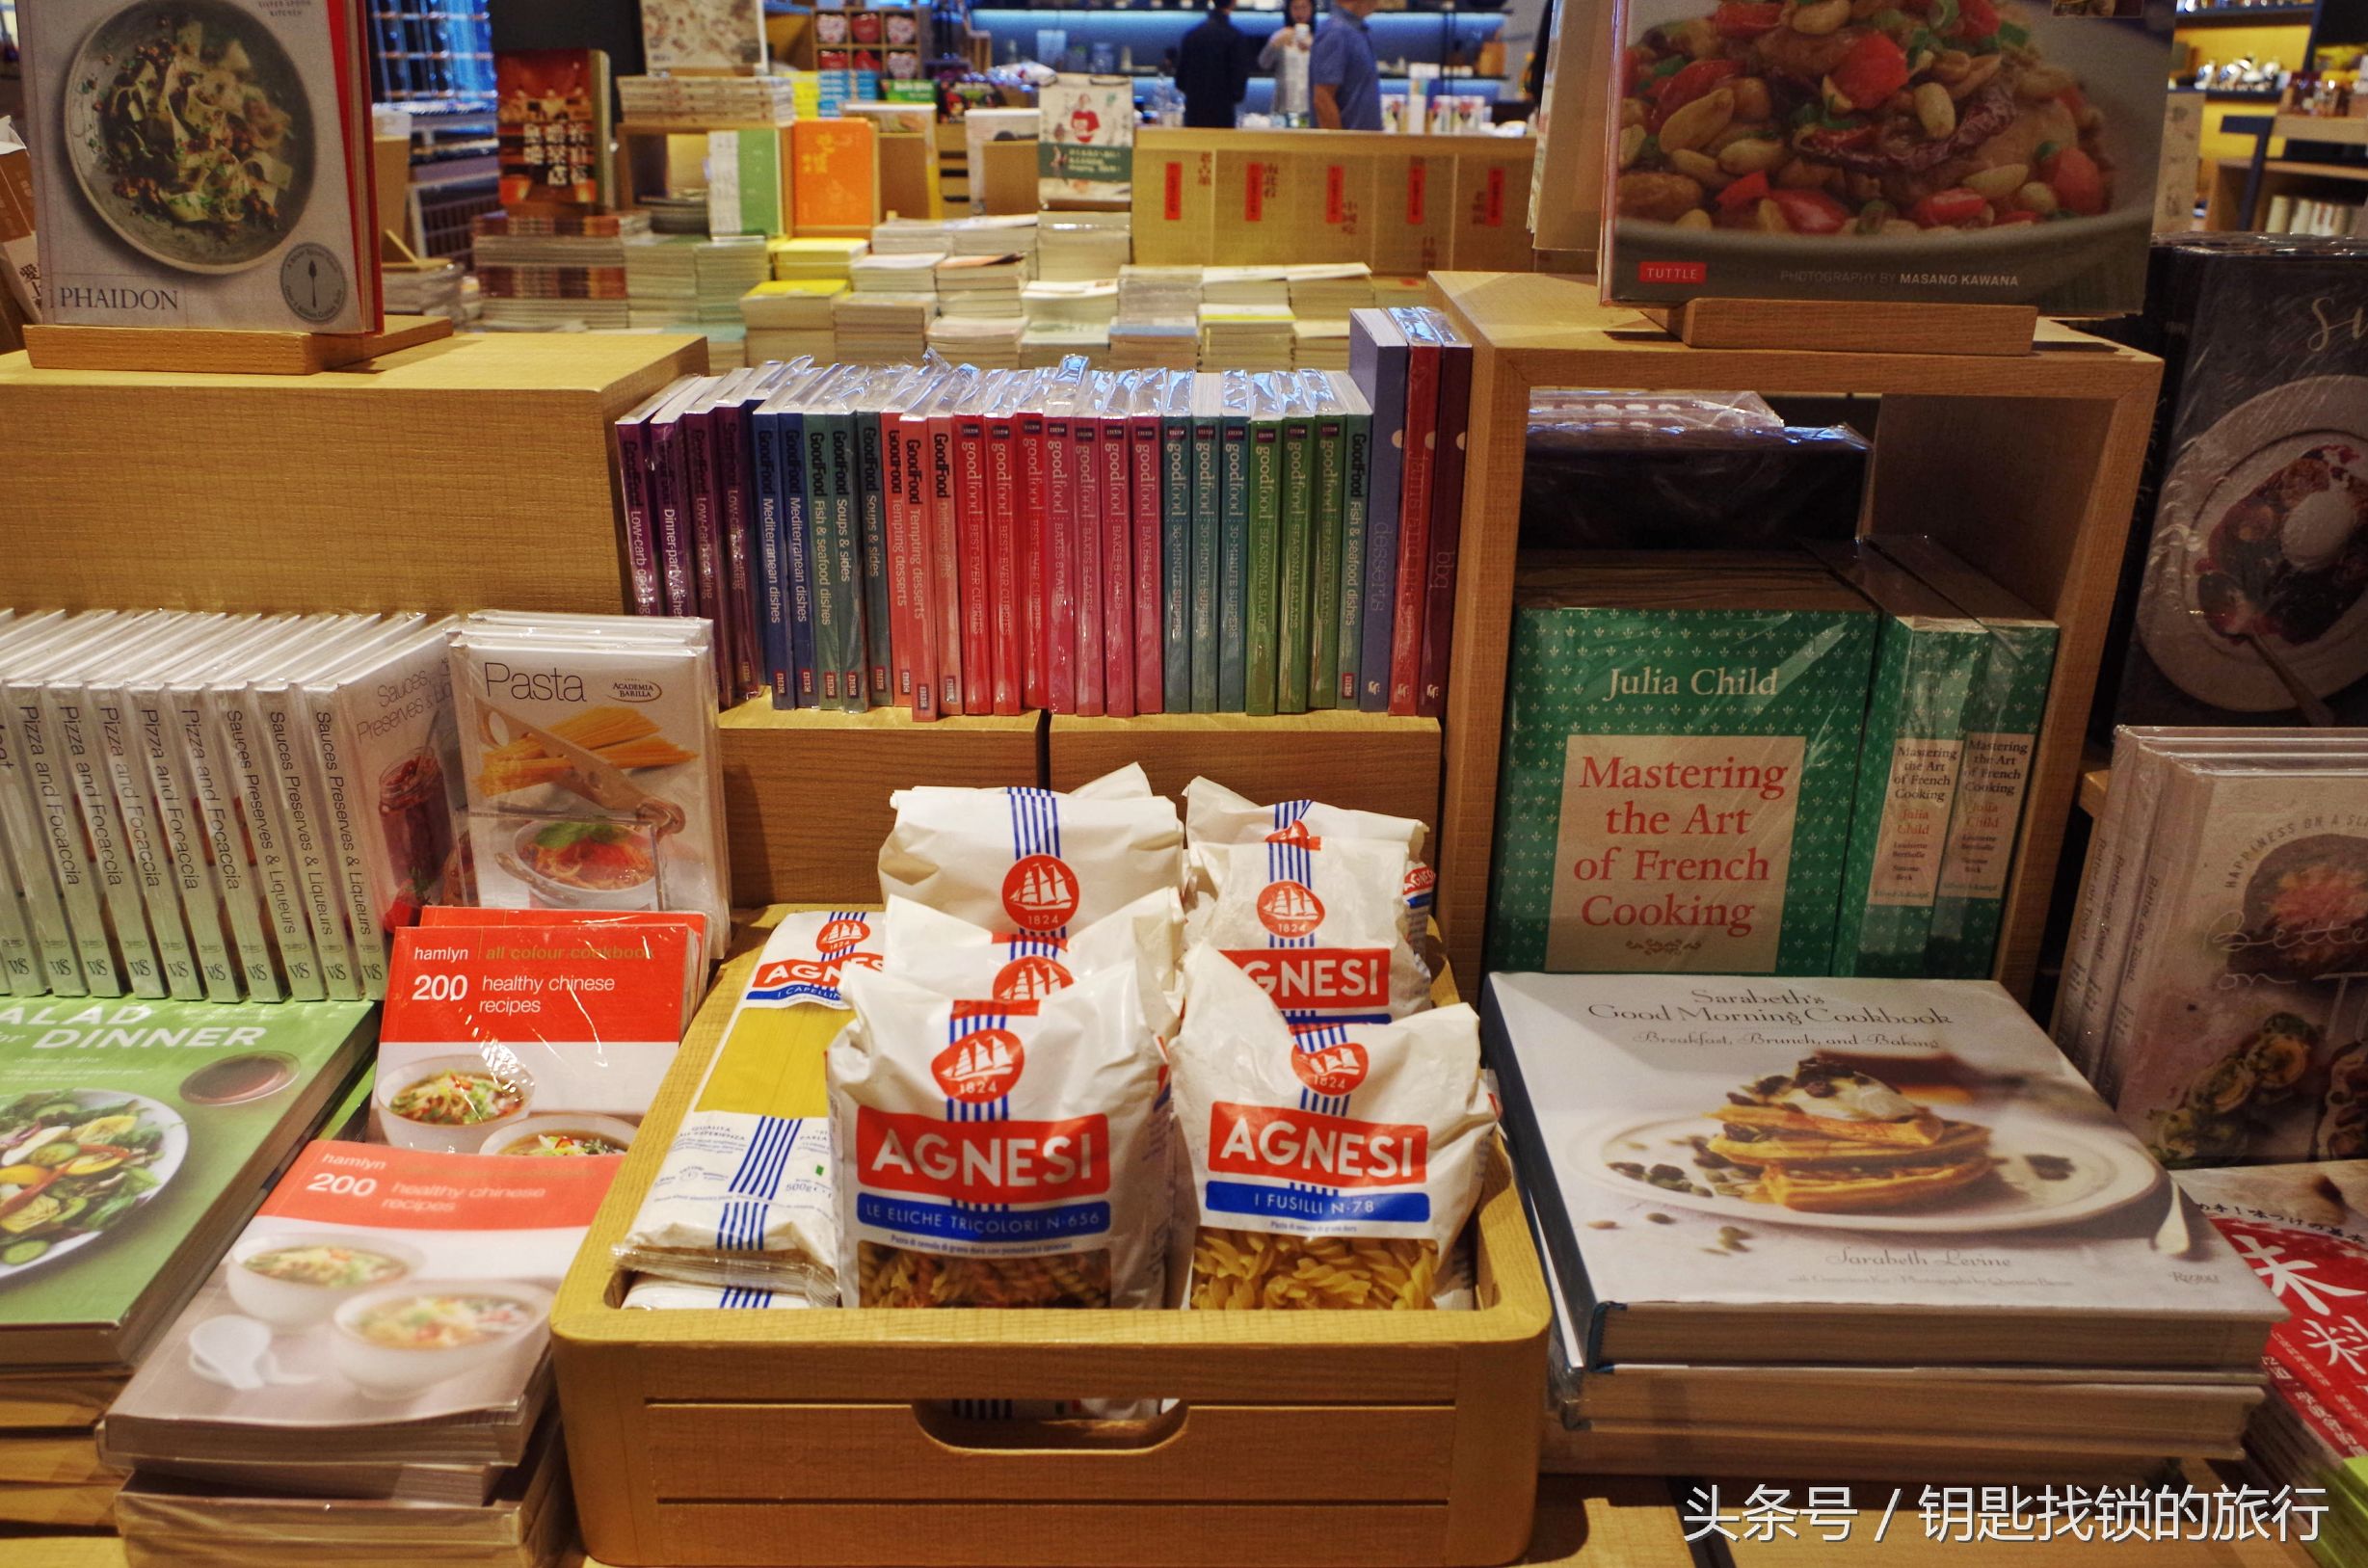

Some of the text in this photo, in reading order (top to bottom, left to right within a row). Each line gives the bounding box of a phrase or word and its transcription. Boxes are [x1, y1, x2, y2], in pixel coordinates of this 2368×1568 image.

[1646, 268, 1698, 280] TUTTLE
[1780, 270, 2020, 287] PHOTOGRAPHY BY MASANO KAWANA
[61, 287, 178, 310] PHAIDON
[934, 433, 950, 499] GoodFood
[1350, 433, 1367, 498] GoodFood
[837, 499, 848, 536] Soups
[866, 494, 877, 531] Soups
[1350, 501, 1362, 526] Fish
[810, 432, 832, 625] GoodFood Fish & seafood dishes
[838, 539, 850, 547] &
[906, 439, 924, 619] GoodFood Tempting desserts
[762, 498, 781, 624] Mediterranean dishes
[789, 497, 808, 623] Mediterranean dishes
[839, 551, 850, 582] sides
[868, 545, 880, 577] sides
[1348, 539, 1360, 586] seafood
[1371, 520, 1394, 612] desserts
[1430, 551, 1455, 590] bbq
[894, 555, 907, 607] desserts
[1345, 589, 1358, 626] dishes
[484, 662, 587, 703] Pasta
[613, 682, 653, 692] ACADEMIA
[619, 690, 652, 699] BARILLA
[1602, 666, 1778, 702] Julia Child
[356, 700, 424, 744] Preserves
[1897, 747, 1958, 760] Mastering
[1968, 739, 2029, 756] Mastering
[1974, 754, 2016, 765] the Art
[1579, 756, 1789, 801] Mastering
[1894, 775, 1951, 785] of French
[1927, 761, 1945, 772] Art
[1981, 768, 2021, 780] French
[19, 705, 81, 886] Pizza and Focaccia
[60, 705, 123, 886] Pizza and Focaccia
[99, 706, 162, 888] Pizza and Focaccia
[140, 708, 200, 890] Pizza and Focaccia
[181, 709, 240, 890] Pizza and Focaccia
[1895, 788, 1946, 803] Cooking
[1965, 782, 2016, 796] Cooking
[226, 709, 296, 935] Sauces Preserves & Liqueurs
[270, 710, 333, 936] Sauces Preserves & Liqueurs
[316, 711, 371, 936] Sauces Preserves & Liqueurs
[1606, 800, 1752, 835] the Art
[1897, 824, 1929, 835] Child
[1573, 846, 1770, 882] of French
[2224, 822, 2296, 889] HAPPINESS
[2330, 814, 2339, 826] A
[2142, 874, 2158, 917] Better
[1027, 915, 1059, 925] 1824
[1277, 923, 1307, 933] 1824
[1581, 892, 1756, 938] Cooking
[413, 945, 653, 963] hamlyn all colour cookbook
[830, 940, 850, 950] 1824
[412, 974, 616, 1001] 200 healthy chinese
[1241, 958, 1378, 997] GNESI
[2216, 972, 2299, 991] on
[479, 998, 542, 1016] recipes
[1690, 989, 1825, 1005] Sarabeth's
[1588, 1003, 1954, 1026] Good Morning Cookbook
[32, 1026, 267, 1049] DINNER
[1825, 1033, 1858, 1046] and
[1861, 1033, 1940, 1050] Baking
[959, 1079, 998, 1094] 1824
[1312, 1075, 1345, 1090] 1824
[322, 1153, 386, 1171] hamlyn
[871, 1128, 1092, 1187] AGNESI
[1220, 1116, 1413, 1179] AGNESI
[306, 1172, 546, 1200] 200 healthy chinese
[381, 1197, 457, 1213] recipes
[866, 1203, 1039, 1234] LE ELICHE TRICOLORI
[1255, 1193, 1322, 1214] I FUSILLI
[1825, 1246, 2011, 1267] Sarabeth Levine
